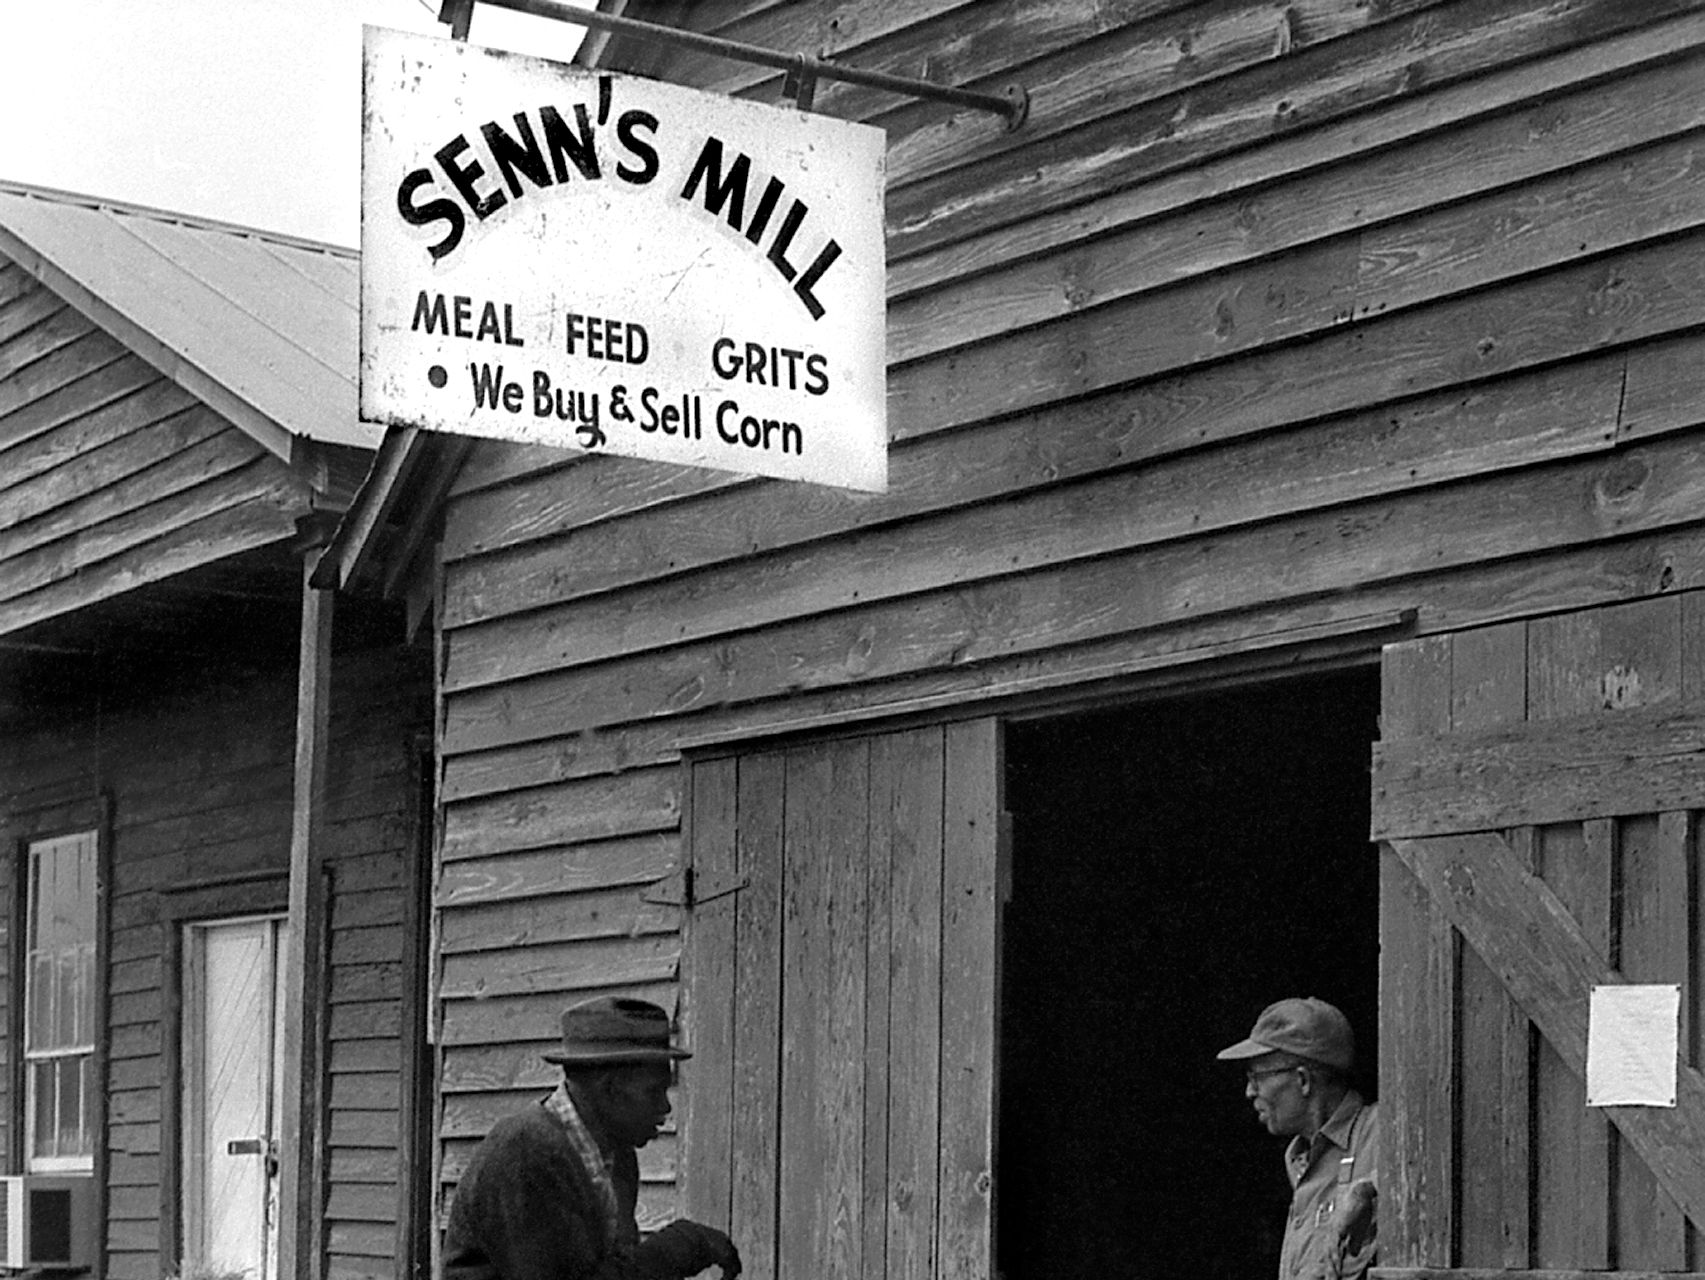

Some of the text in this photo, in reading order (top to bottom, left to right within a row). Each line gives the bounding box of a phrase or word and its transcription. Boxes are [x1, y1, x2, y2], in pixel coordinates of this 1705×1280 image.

[397, 75, 843, 321] SENN'S MILL
[411, 290, 829, 396] MEAL FEED GRITS
[470, 362, 803, 456] We Buy & Sell Corn
